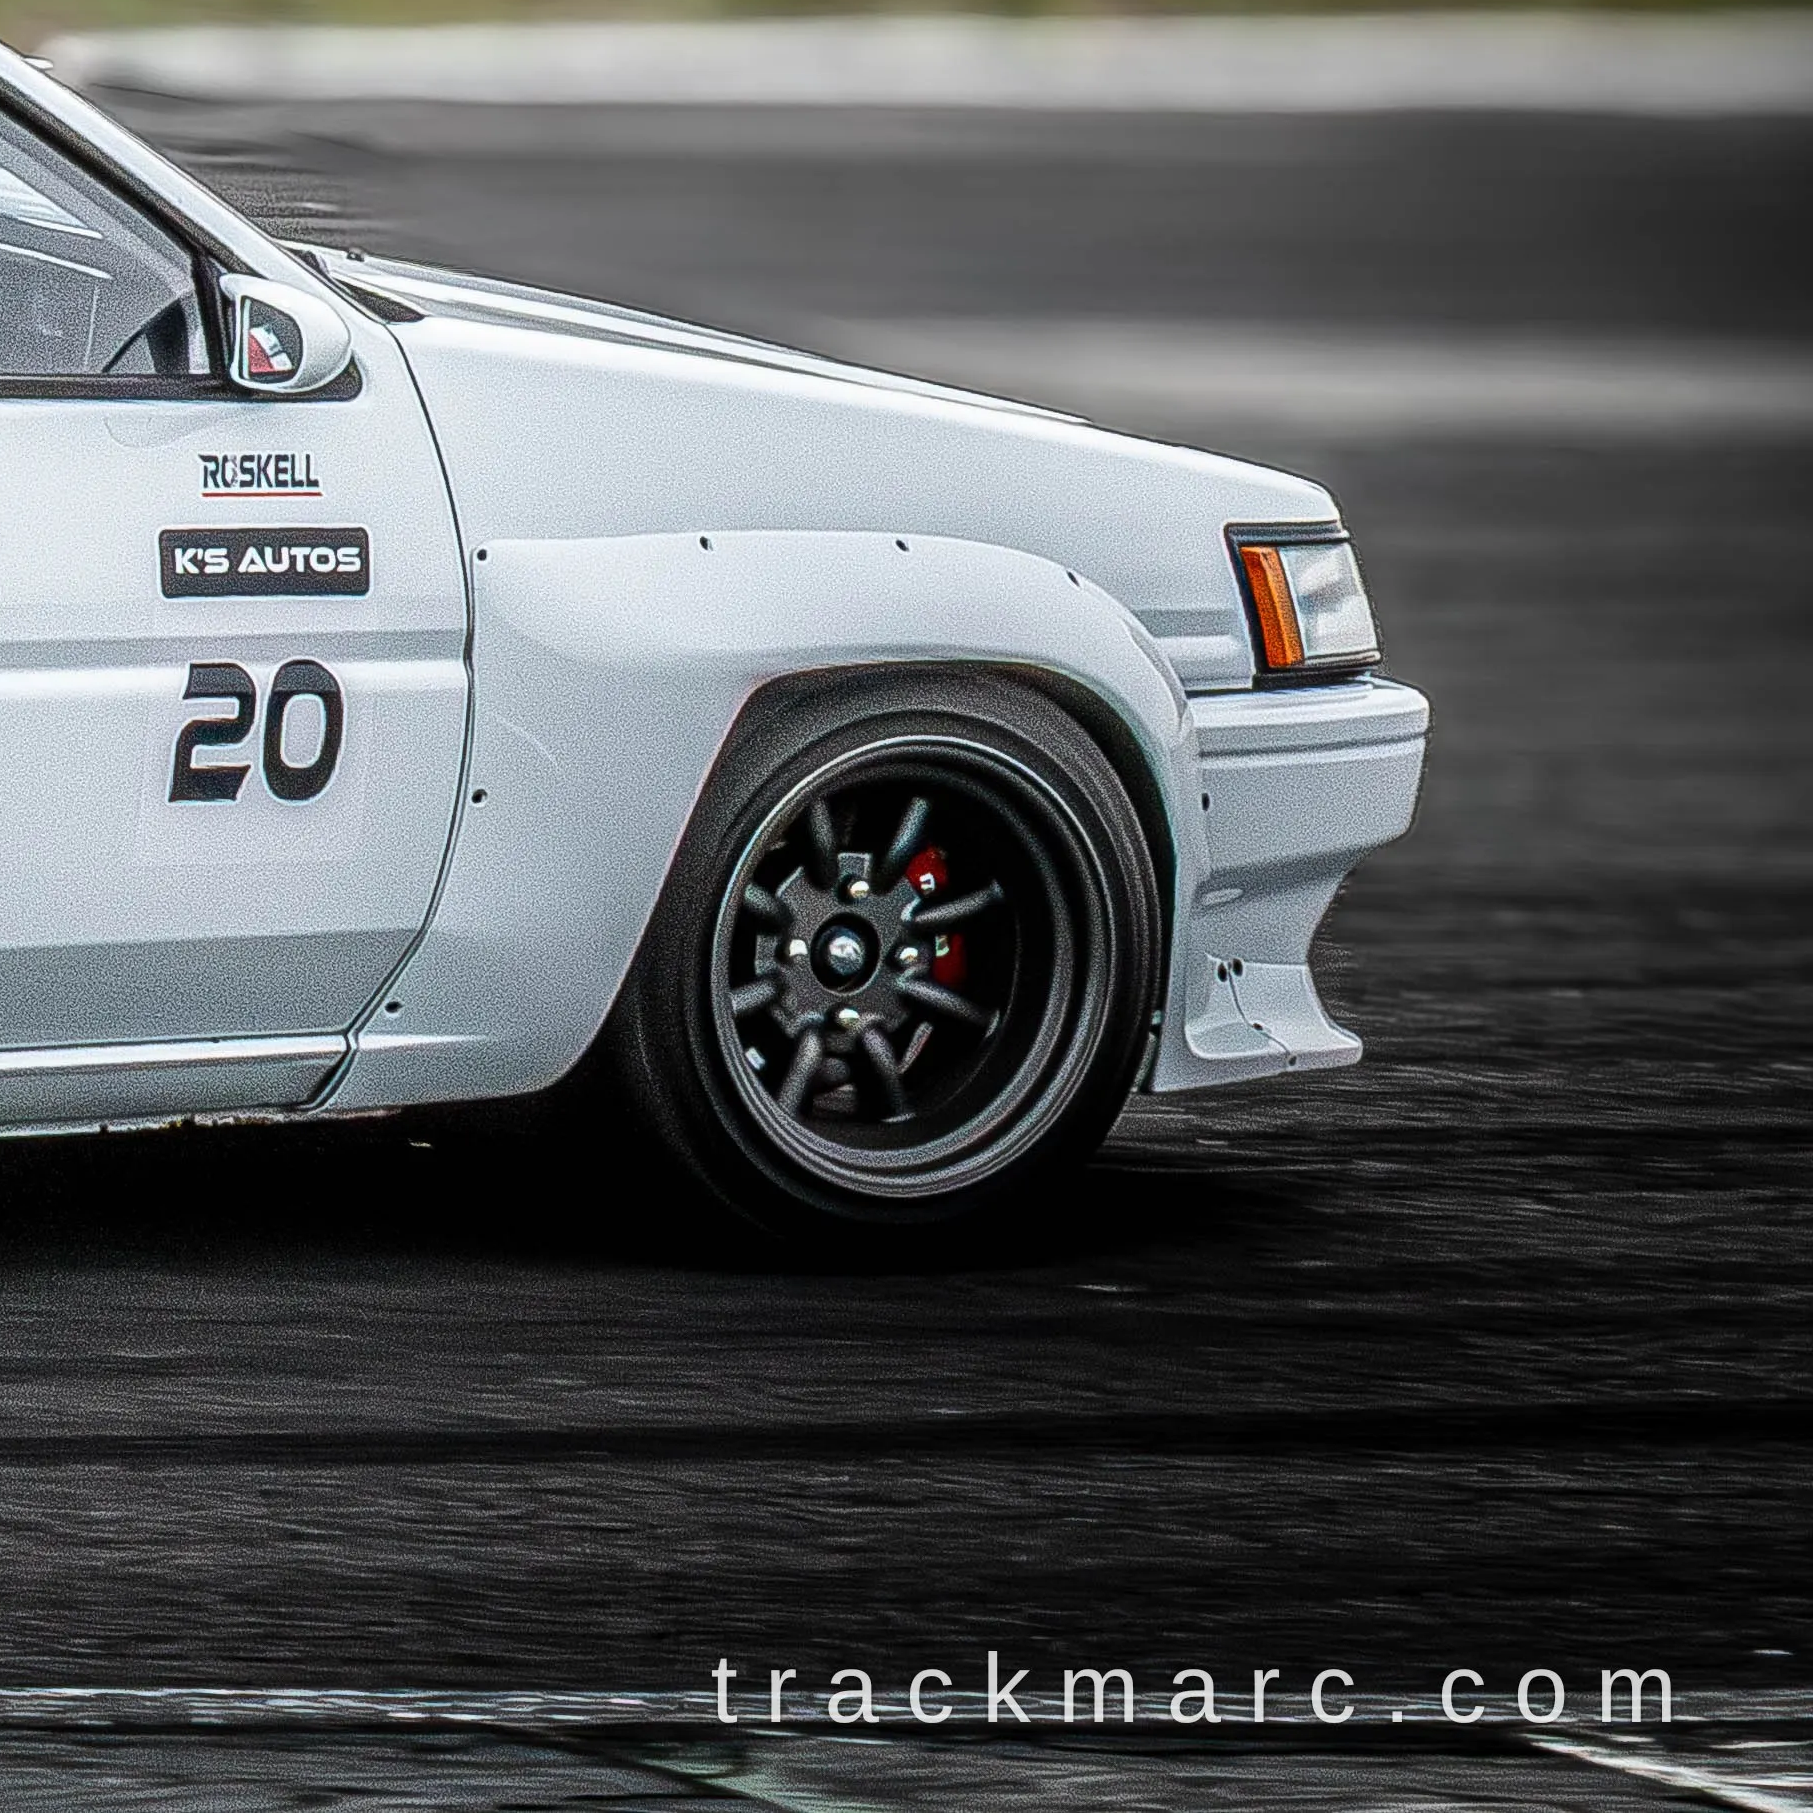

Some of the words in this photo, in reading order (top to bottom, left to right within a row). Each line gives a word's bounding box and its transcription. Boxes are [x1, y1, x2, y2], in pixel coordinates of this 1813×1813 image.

[198, 453, 320, 489] ROSKELL
[174, 547, 230, 575] K'S
[237, 546, 363, 574] AUTOS
[167, 659, 344, 803] 20
